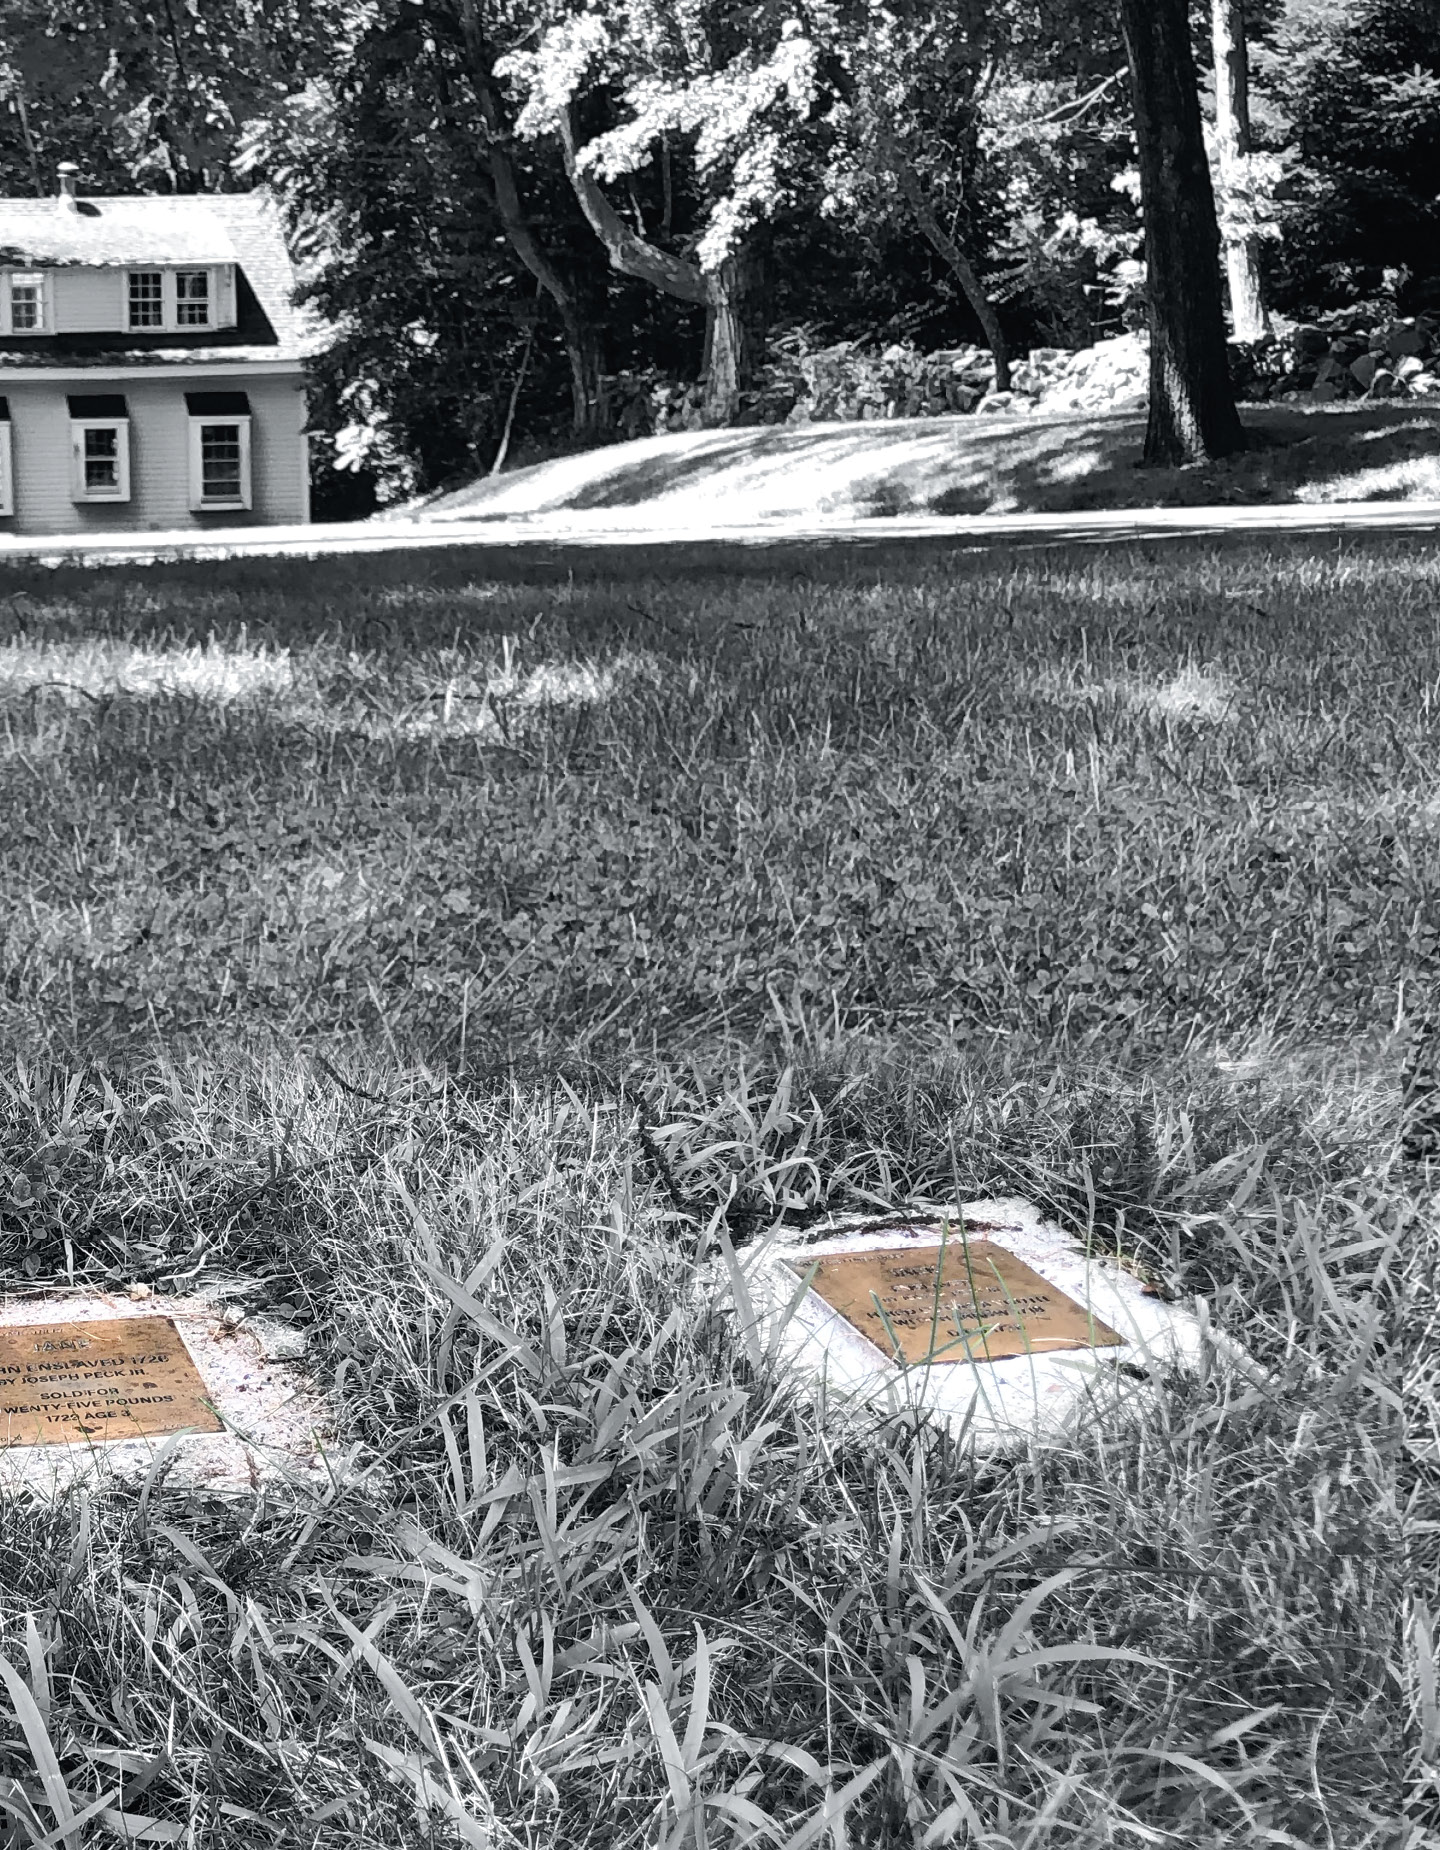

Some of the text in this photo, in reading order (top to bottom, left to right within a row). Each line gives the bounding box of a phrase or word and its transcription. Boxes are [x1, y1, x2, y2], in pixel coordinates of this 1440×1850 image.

[26, 1357, 125, 1373] ENSLAVED
[21, 1373, 80, 1384] JOSEPH
[84, 1370, 126, 1379] PECK
[40, 1387, 120, 1400] SOLD FOR
[106, 1395, 174, 1406] POUNDS
[85, 1410, 118, 1420] AGE
